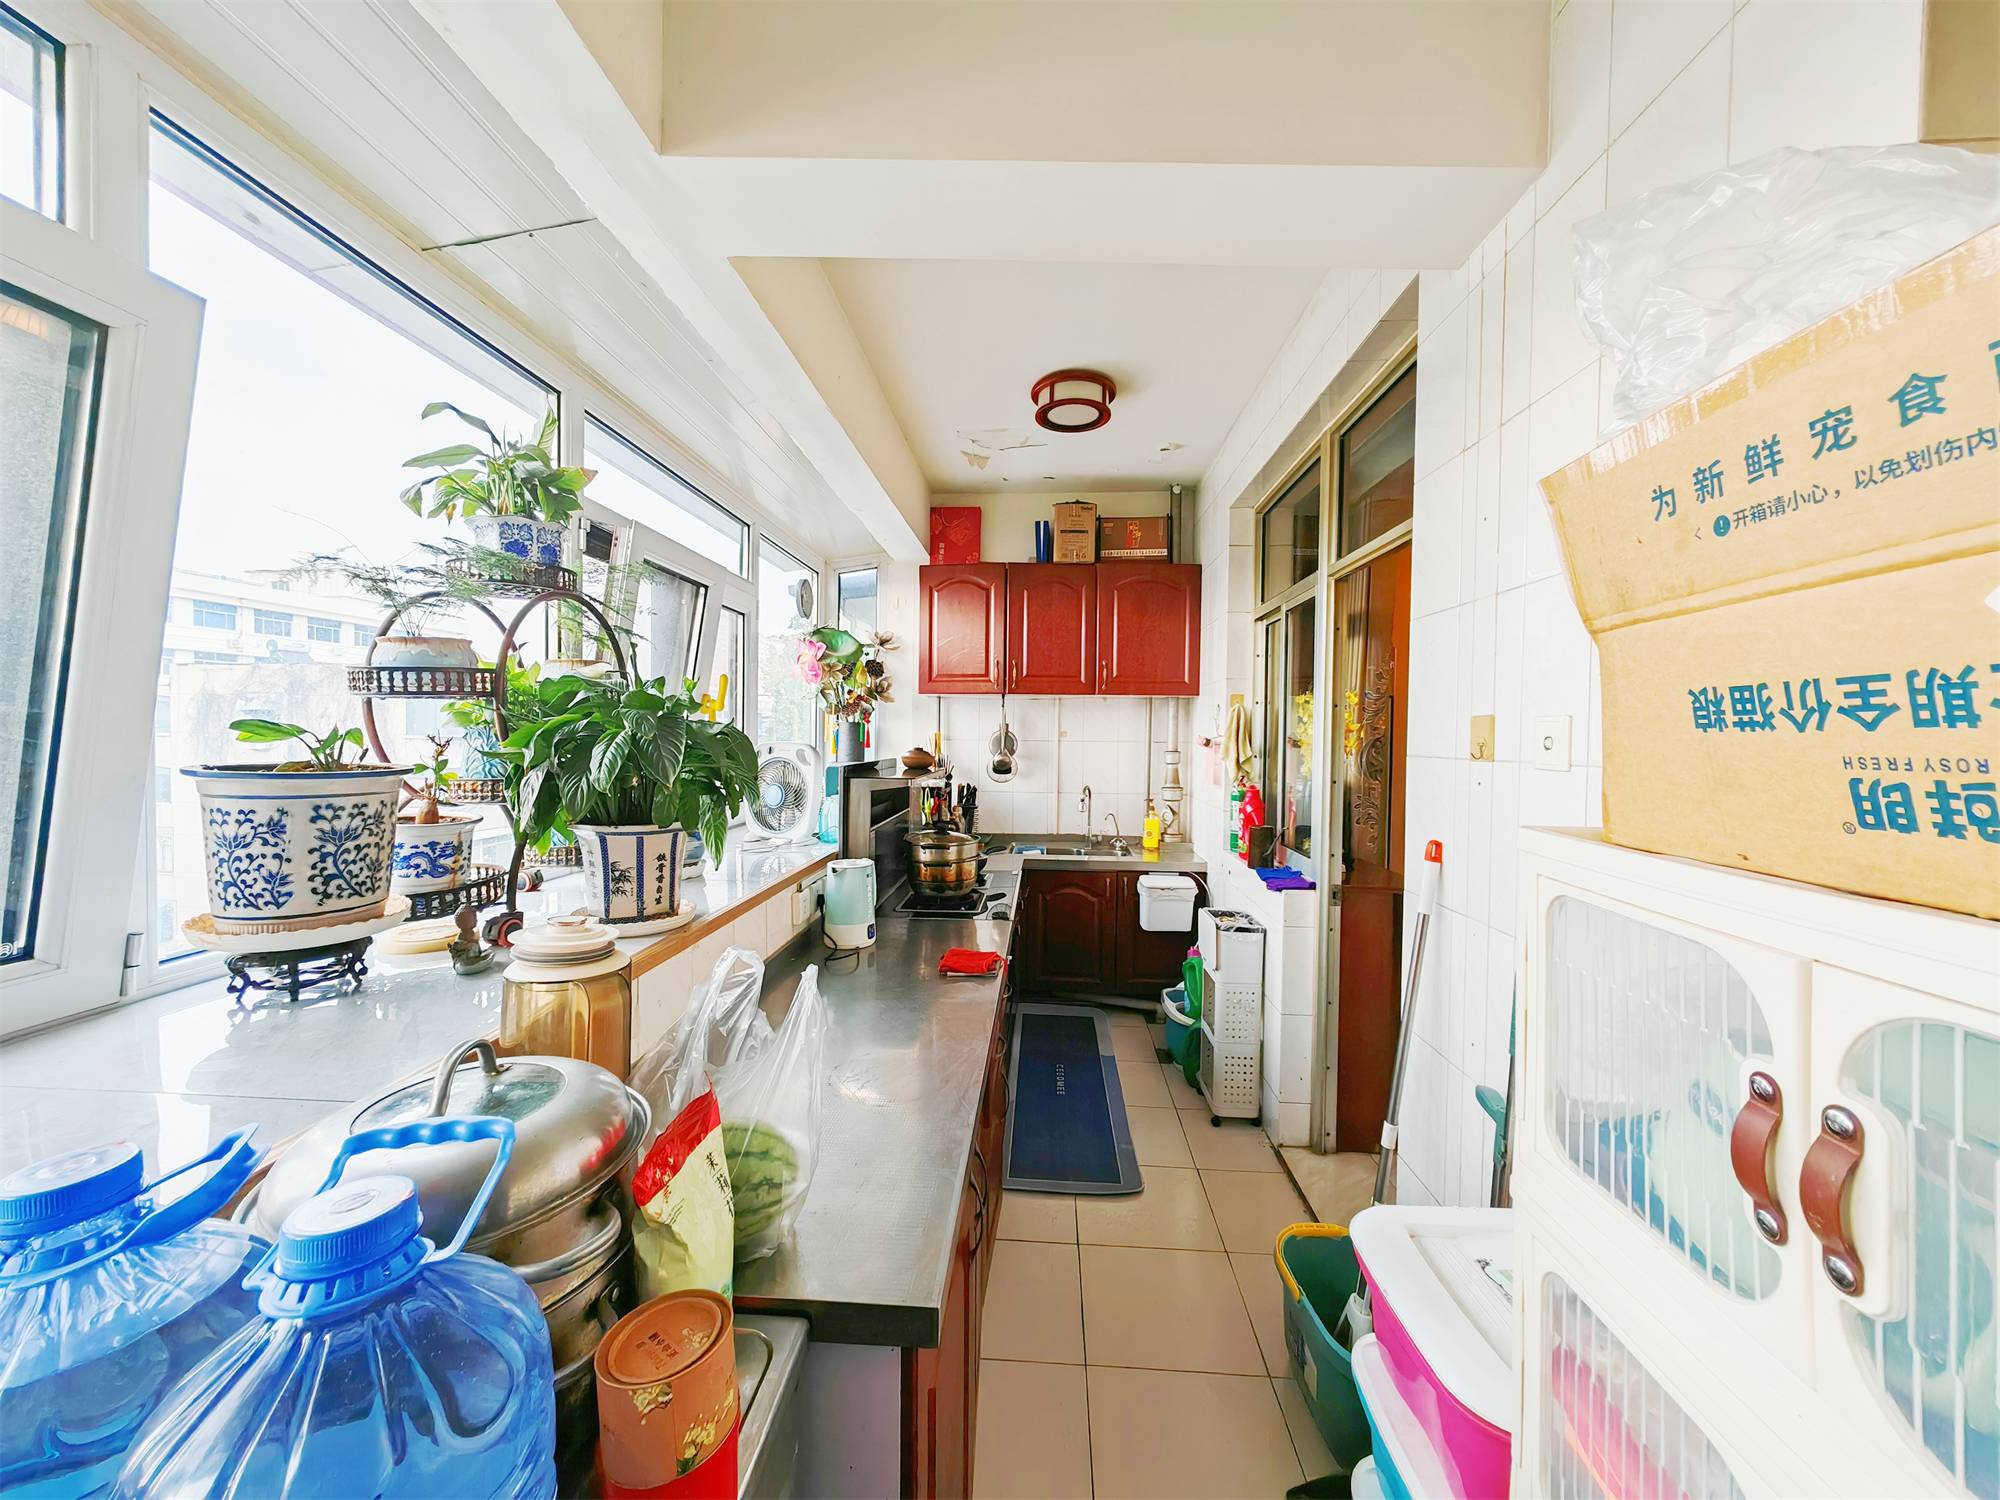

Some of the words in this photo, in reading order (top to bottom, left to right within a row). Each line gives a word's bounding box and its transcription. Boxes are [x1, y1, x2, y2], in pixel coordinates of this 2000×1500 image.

[1688, 664, 2000, 733] 期全价猫粮
[1842, 756, 1913, 772] FRESH
[1924, 757, 1990, 774] ROSY
